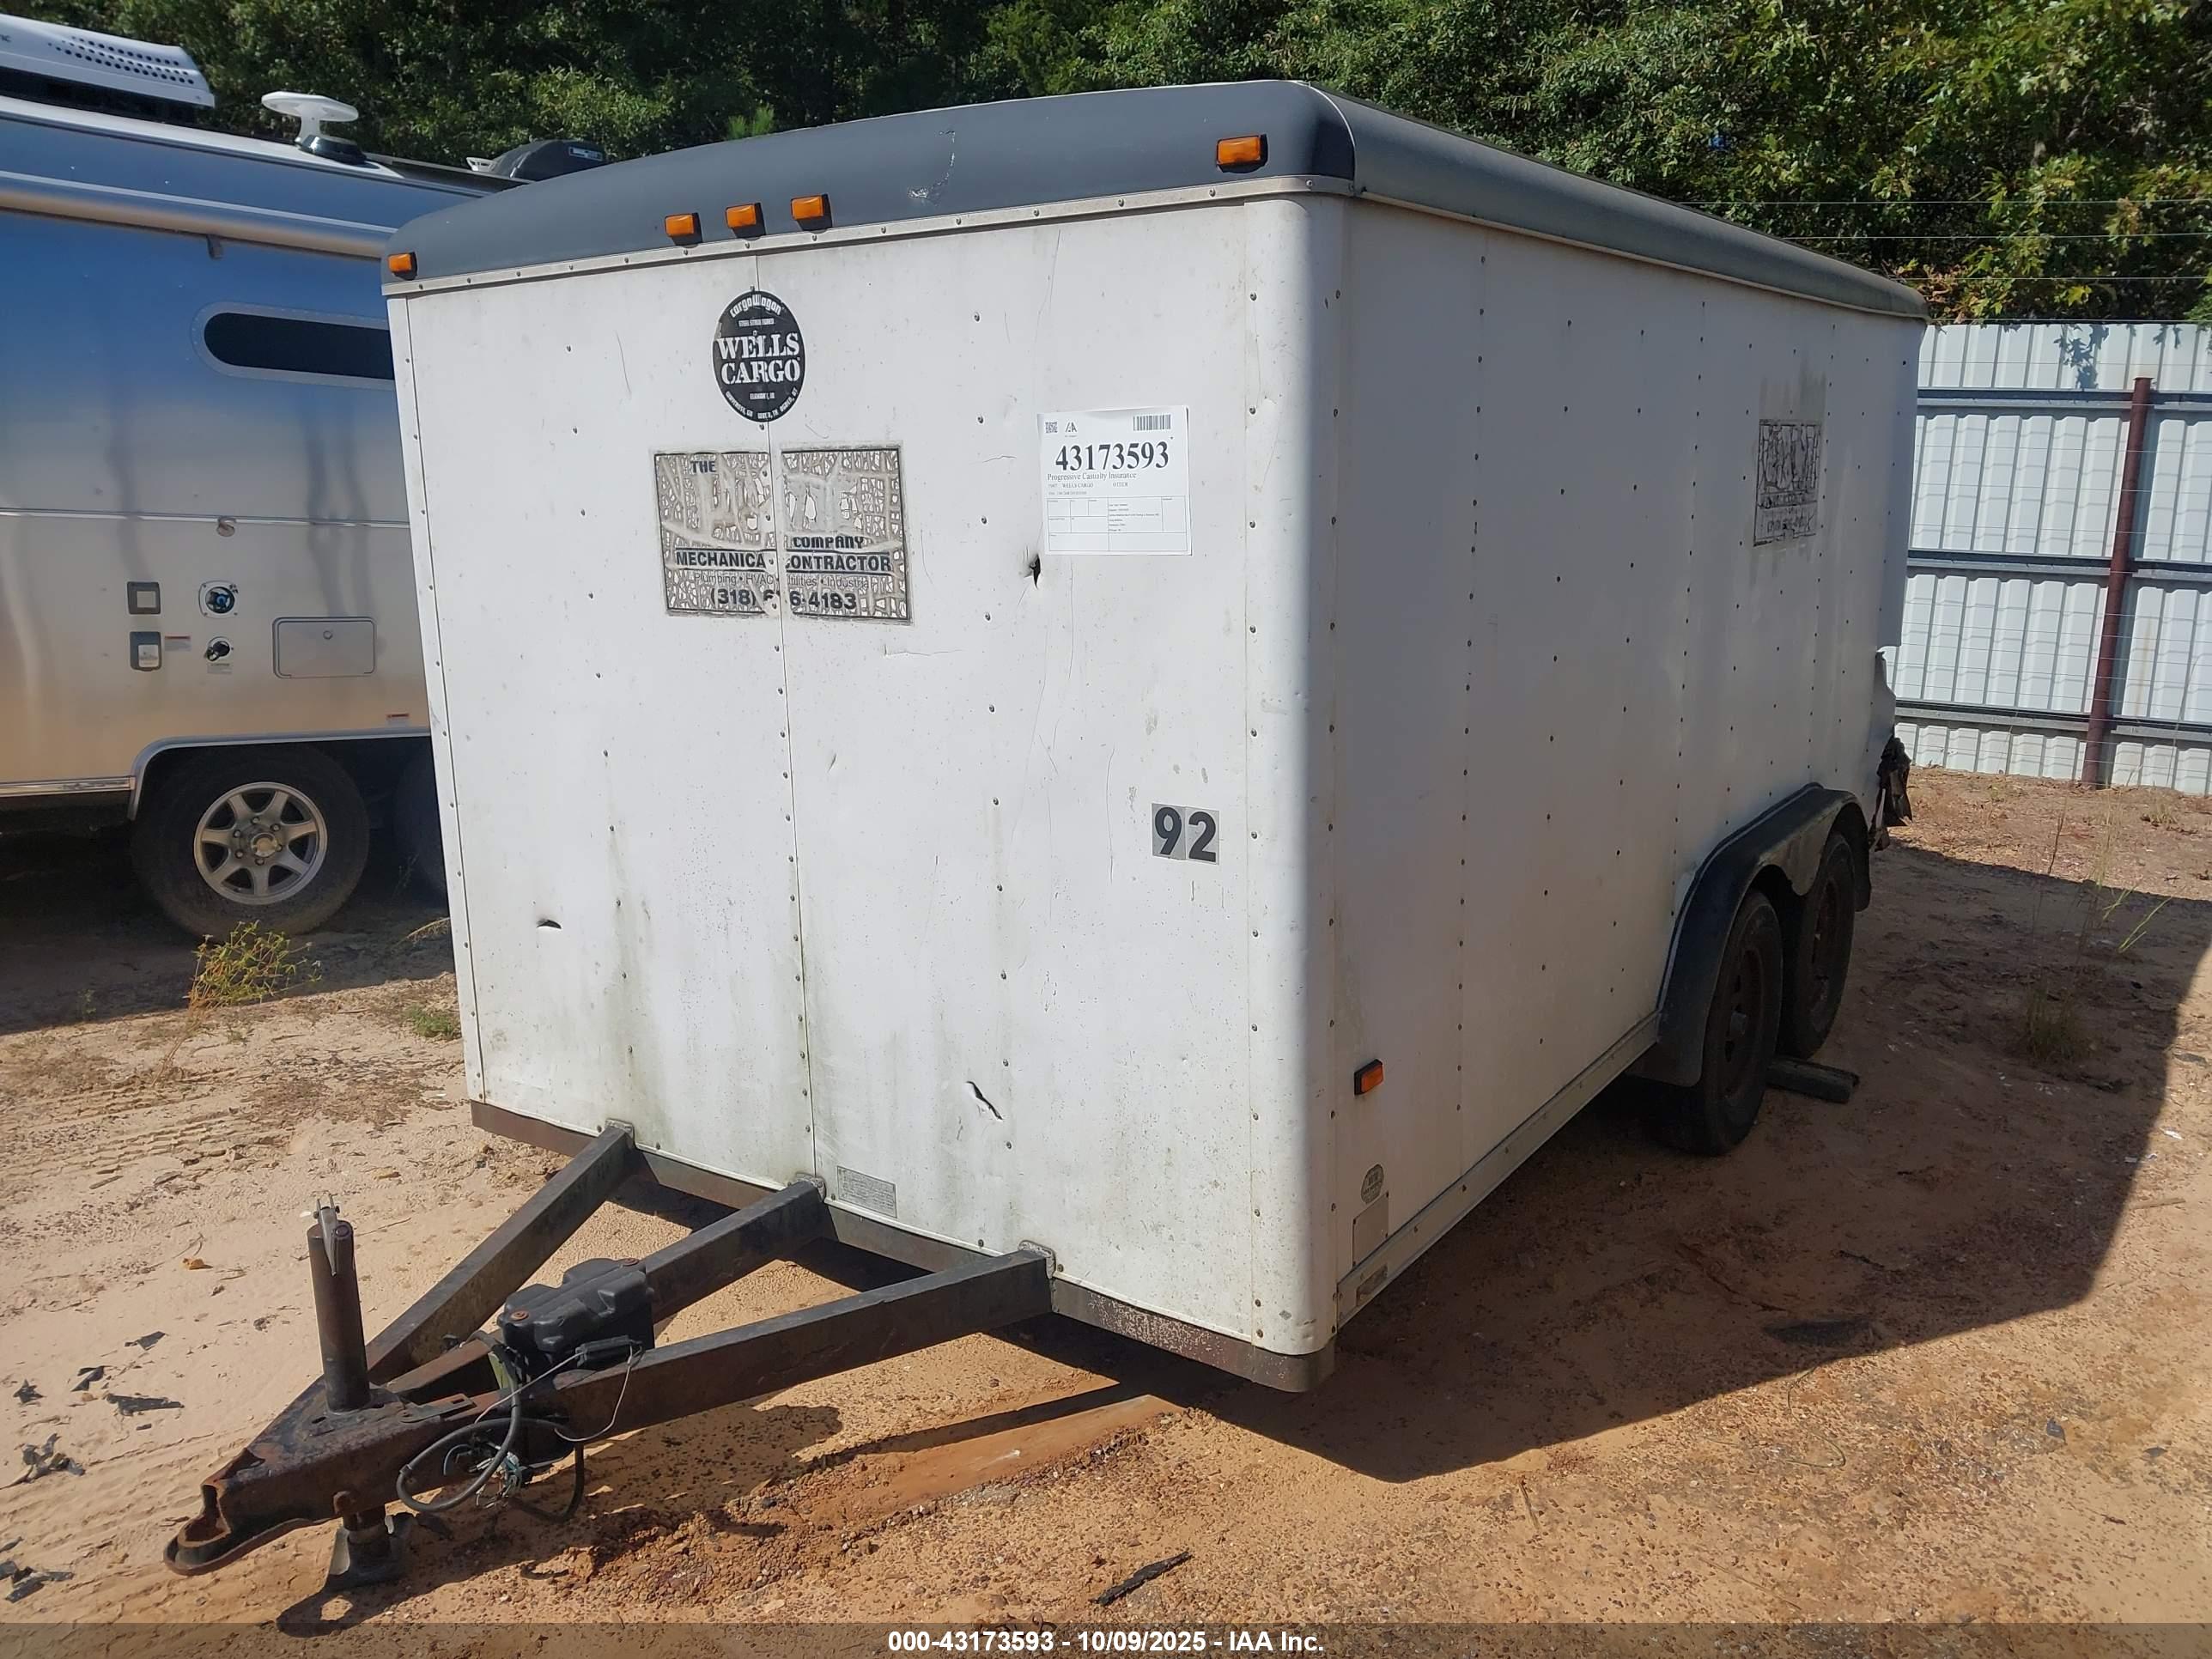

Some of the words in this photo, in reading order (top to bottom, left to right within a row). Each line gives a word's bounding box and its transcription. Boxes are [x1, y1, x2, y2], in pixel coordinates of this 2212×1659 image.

[730, 294, 782, 318] cargoWagon
[716, 332, 800, 360] WELLS
[720, 359, 800, 385] CARGO
[691, 460, 716, 473] THE
[1055, 441, 1170, 471] 43173593
[1047, 473, 1081, 483] Progressive
[1082, 472, 1107, 481] Casualty
[793, 535, 865, 550] COMPANY
[676, 551, 766, 568] MECHANICA
[694, 573, 737, 586] Plumbing
[710, 587, 757, 606] (318)
[763, 589, 857, 611] 66-4183
[1155, 806, 1216, 863] 92
